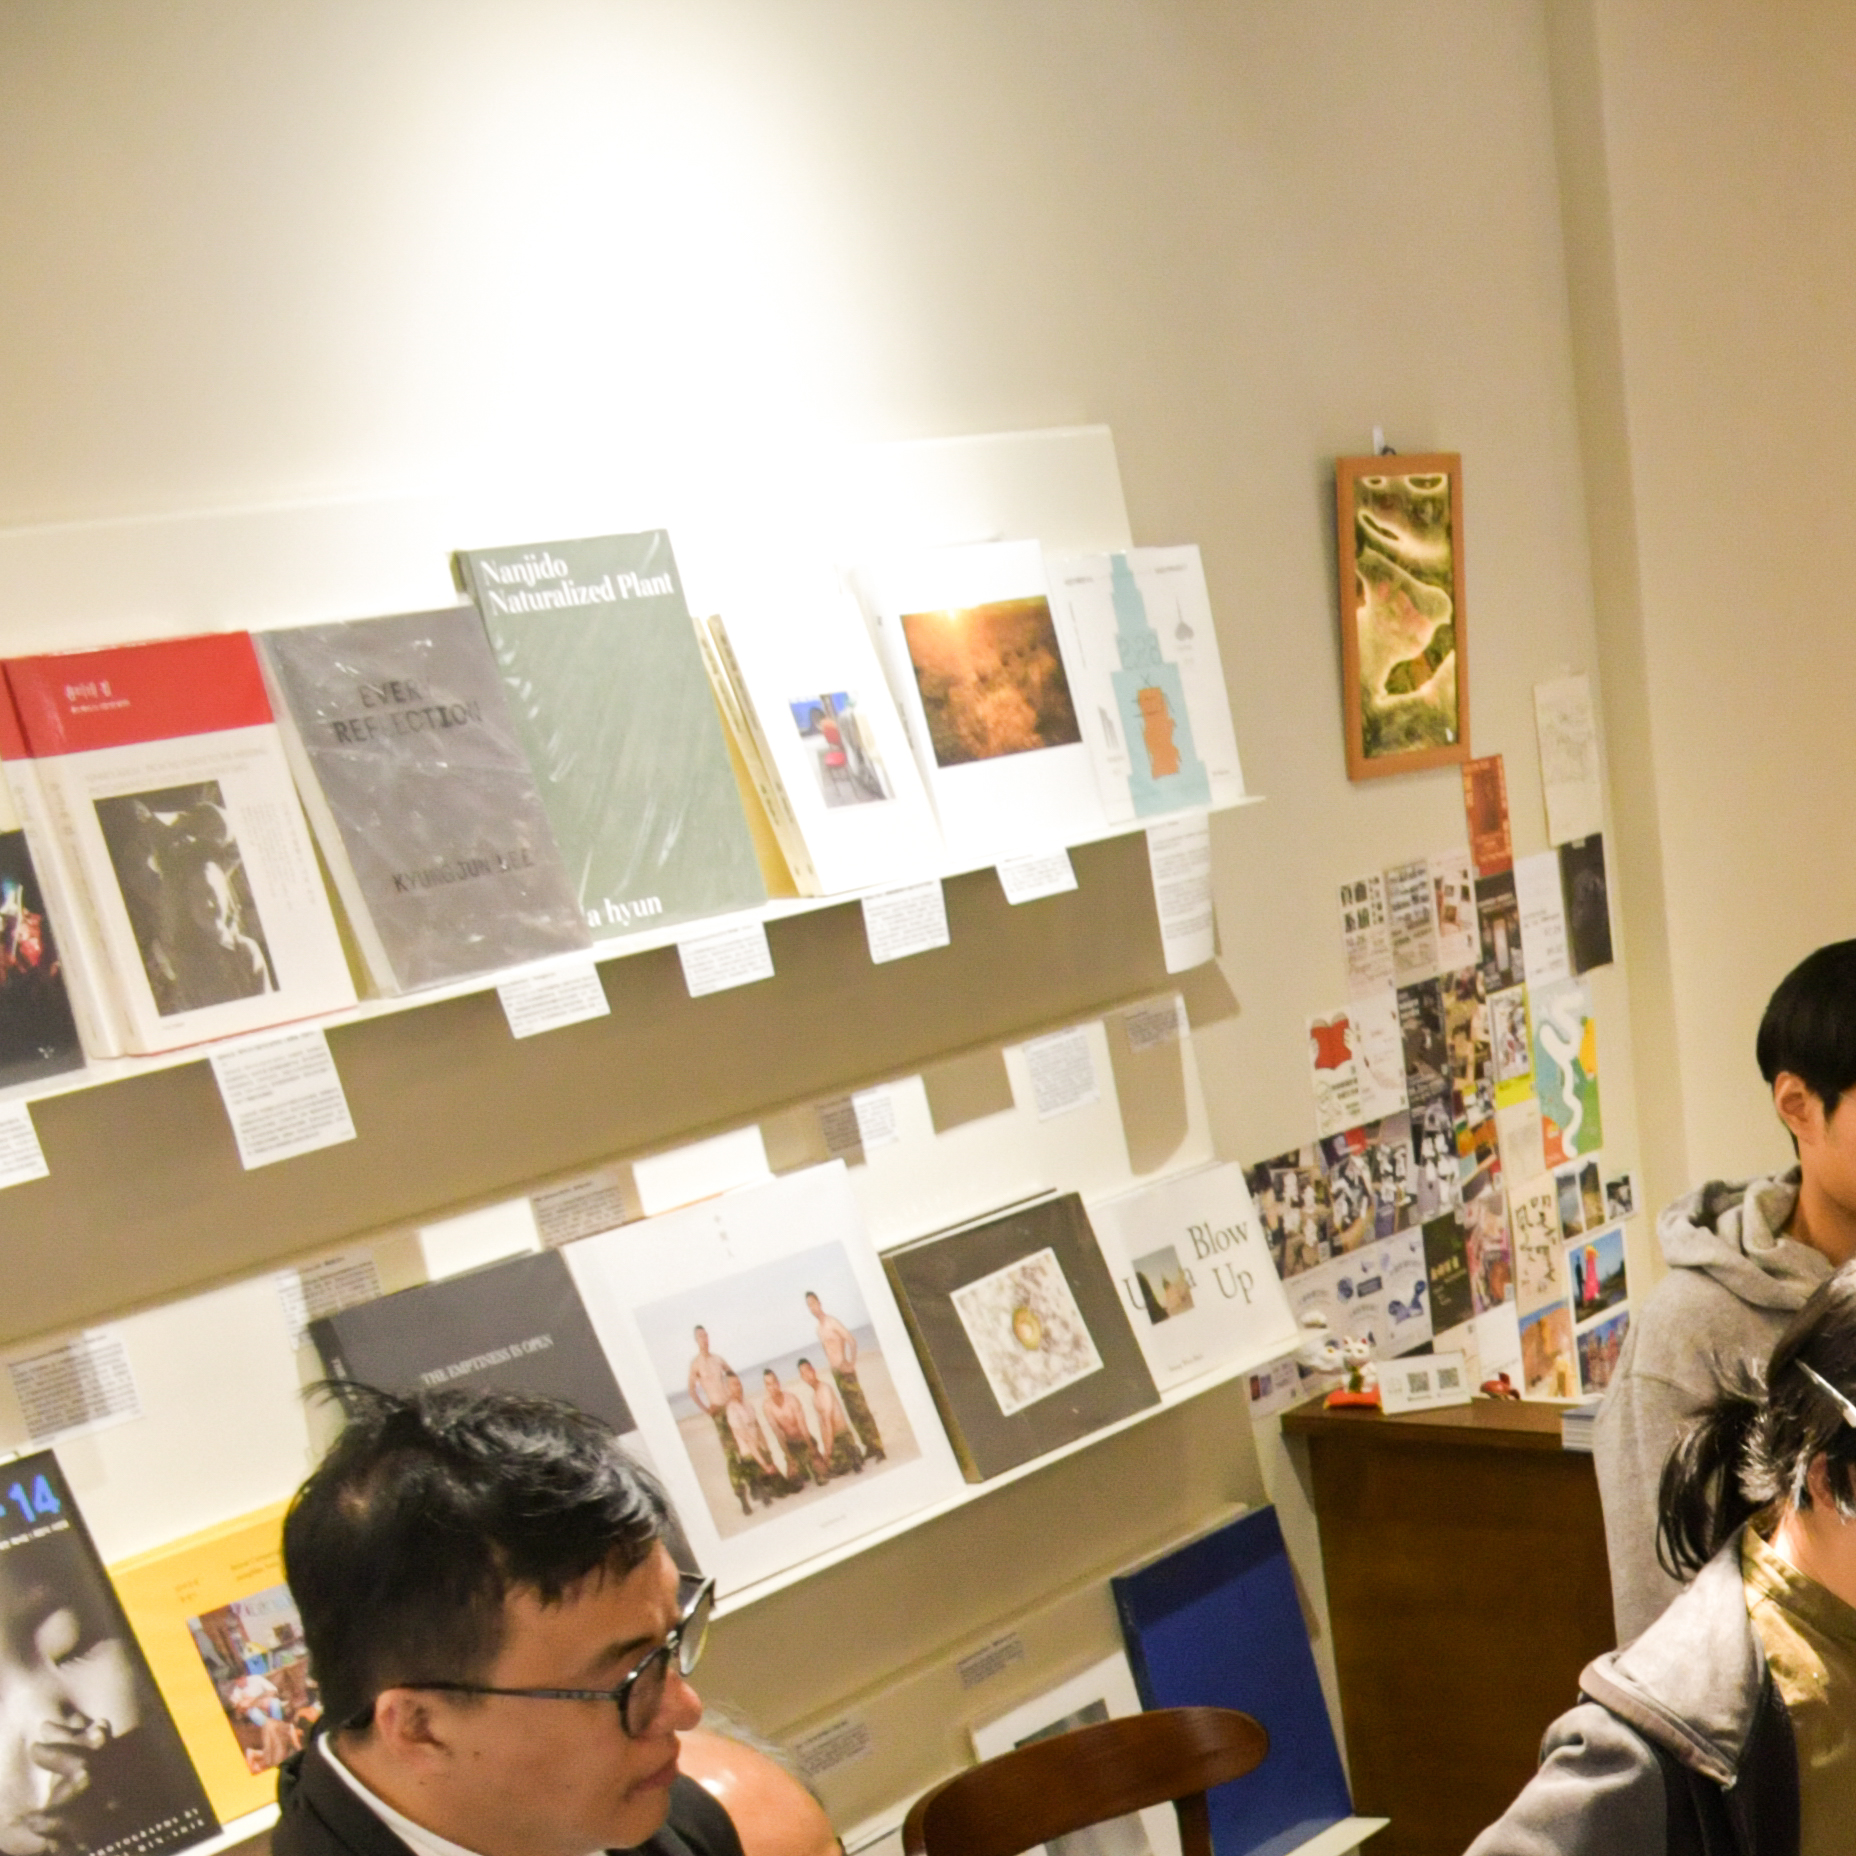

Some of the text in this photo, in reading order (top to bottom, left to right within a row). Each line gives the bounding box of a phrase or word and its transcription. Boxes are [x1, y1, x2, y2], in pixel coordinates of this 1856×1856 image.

[480, 552, 568, 587] Nanjido
[488, 571, 674, 616] Naturalized Plant
[604, 896, 663, 927] hyun
[1187, 1220, 1249, 1261] Blow
[1212, 1262, 1254, 1304] Up
[420, 1333, 553, 1386] THE EMPTINESS IS OPEN
